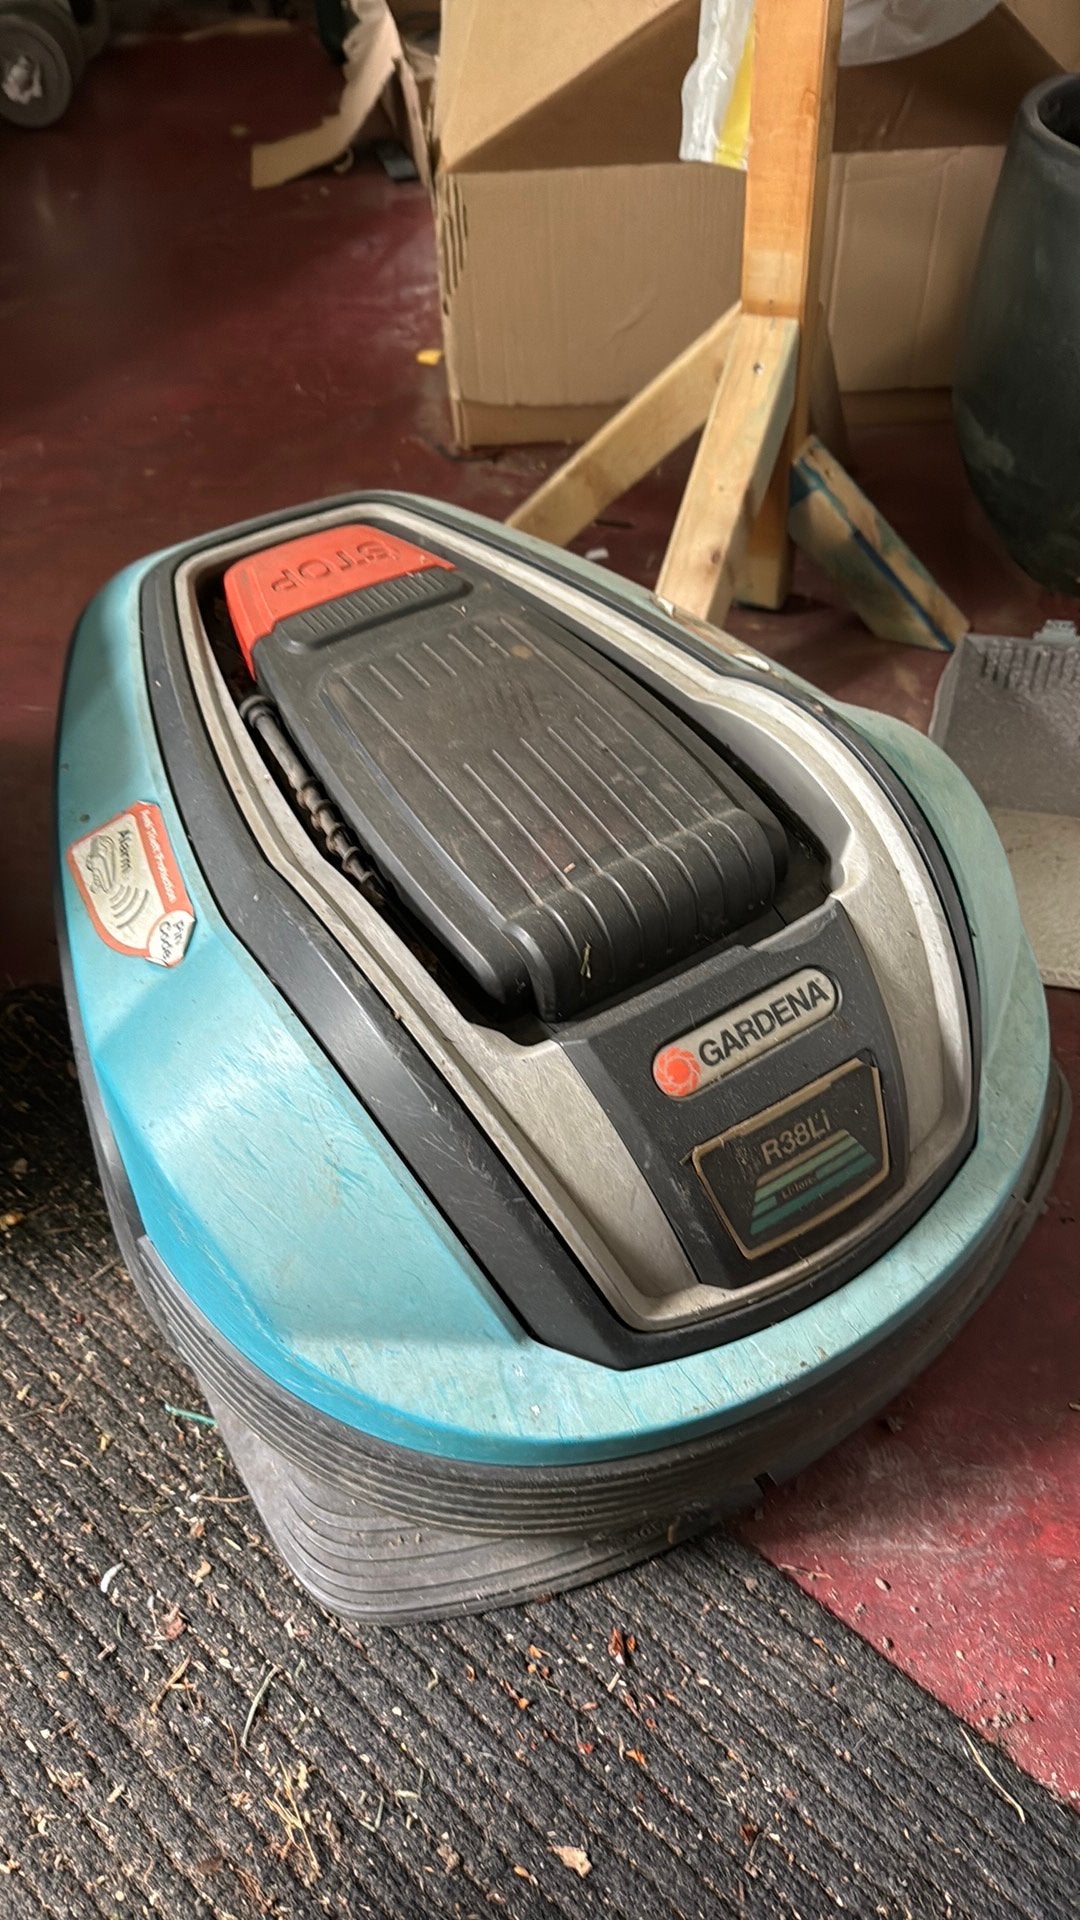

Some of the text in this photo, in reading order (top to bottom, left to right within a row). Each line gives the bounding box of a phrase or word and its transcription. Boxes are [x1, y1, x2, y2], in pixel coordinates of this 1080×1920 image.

[271, 541, 396, 592] STOP
[118, 830, 132, 874] Alarm
[160, 921, 172, 960] Code
[699, 980, 829, 1067] GARDENA
[761, 1108, 831, 1165] R38Li
